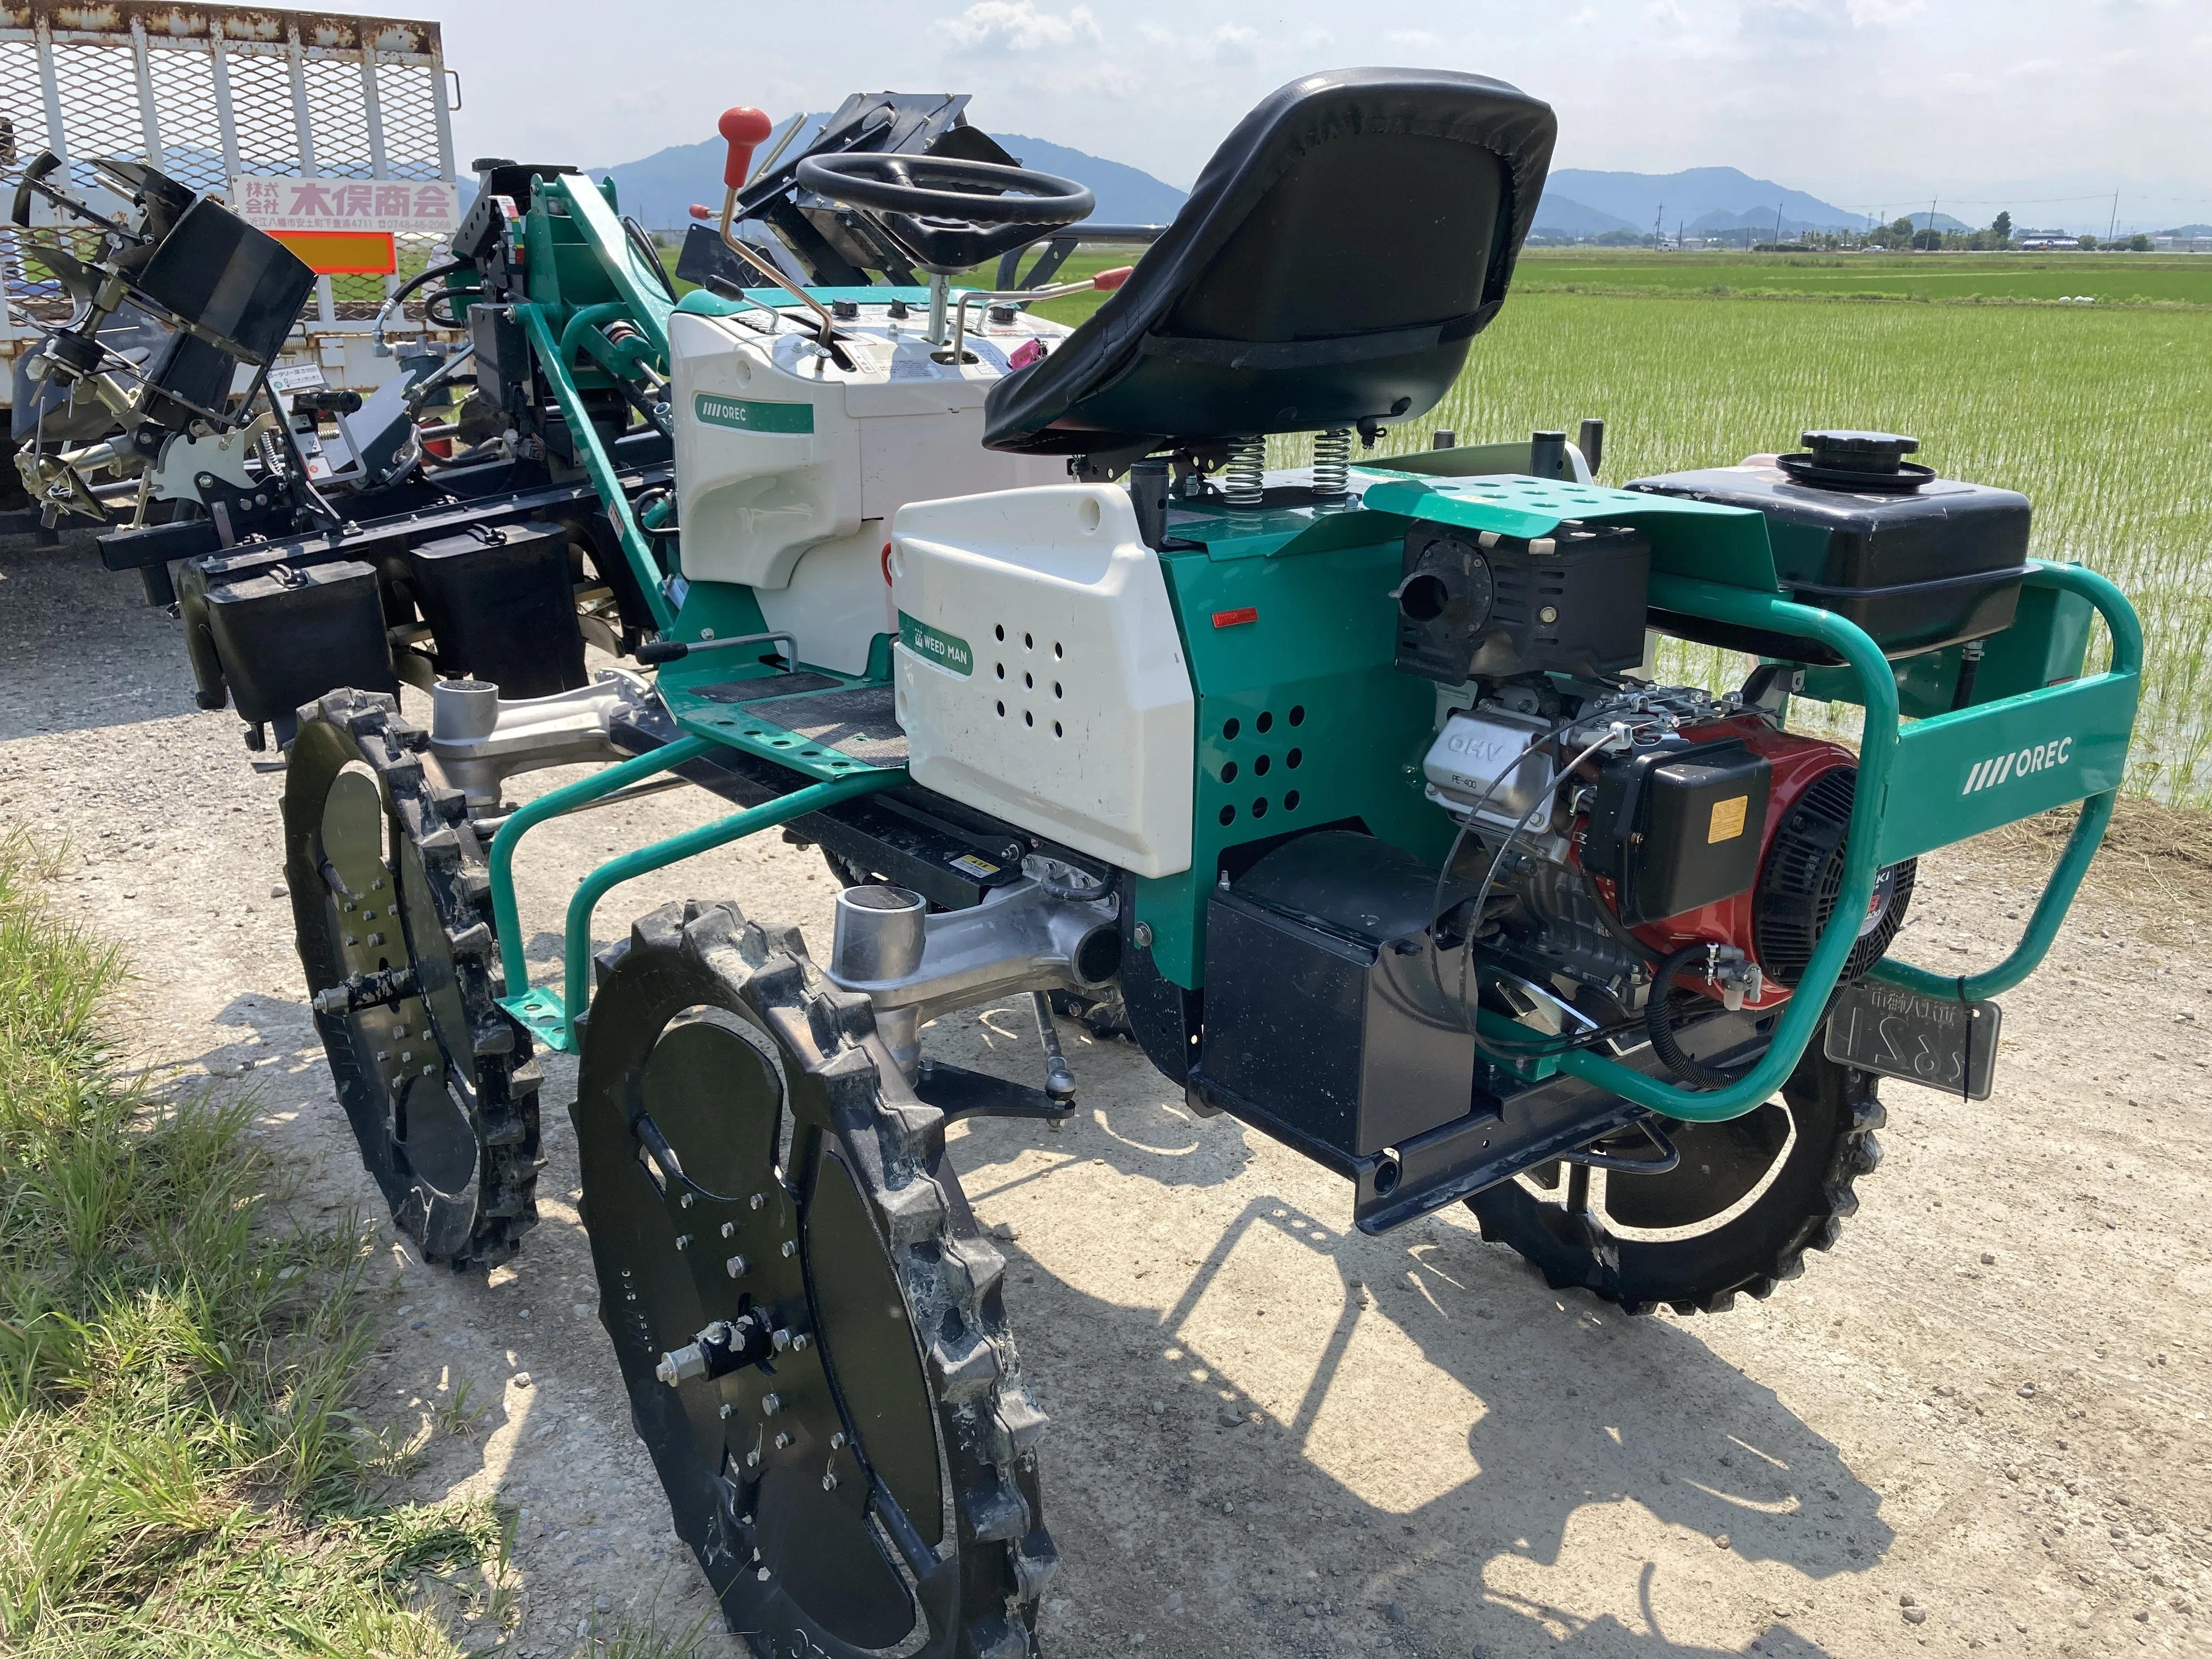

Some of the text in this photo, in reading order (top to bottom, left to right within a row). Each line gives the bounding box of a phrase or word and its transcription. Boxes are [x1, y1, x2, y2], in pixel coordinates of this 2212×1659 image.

[246, 182, 279, 198] 株式
[289, 183, 450, 218] 木俣商会
[246, 199, 279, 215] 会社
[722, 405, 747, 421] OREC
[923, 634, 967, 665] WEED MAN
[1448, 733, 1504, 762] OHV
[2016, 737, 2073, 777] OREC
[1452, 774, 1477, 789] PE-400
